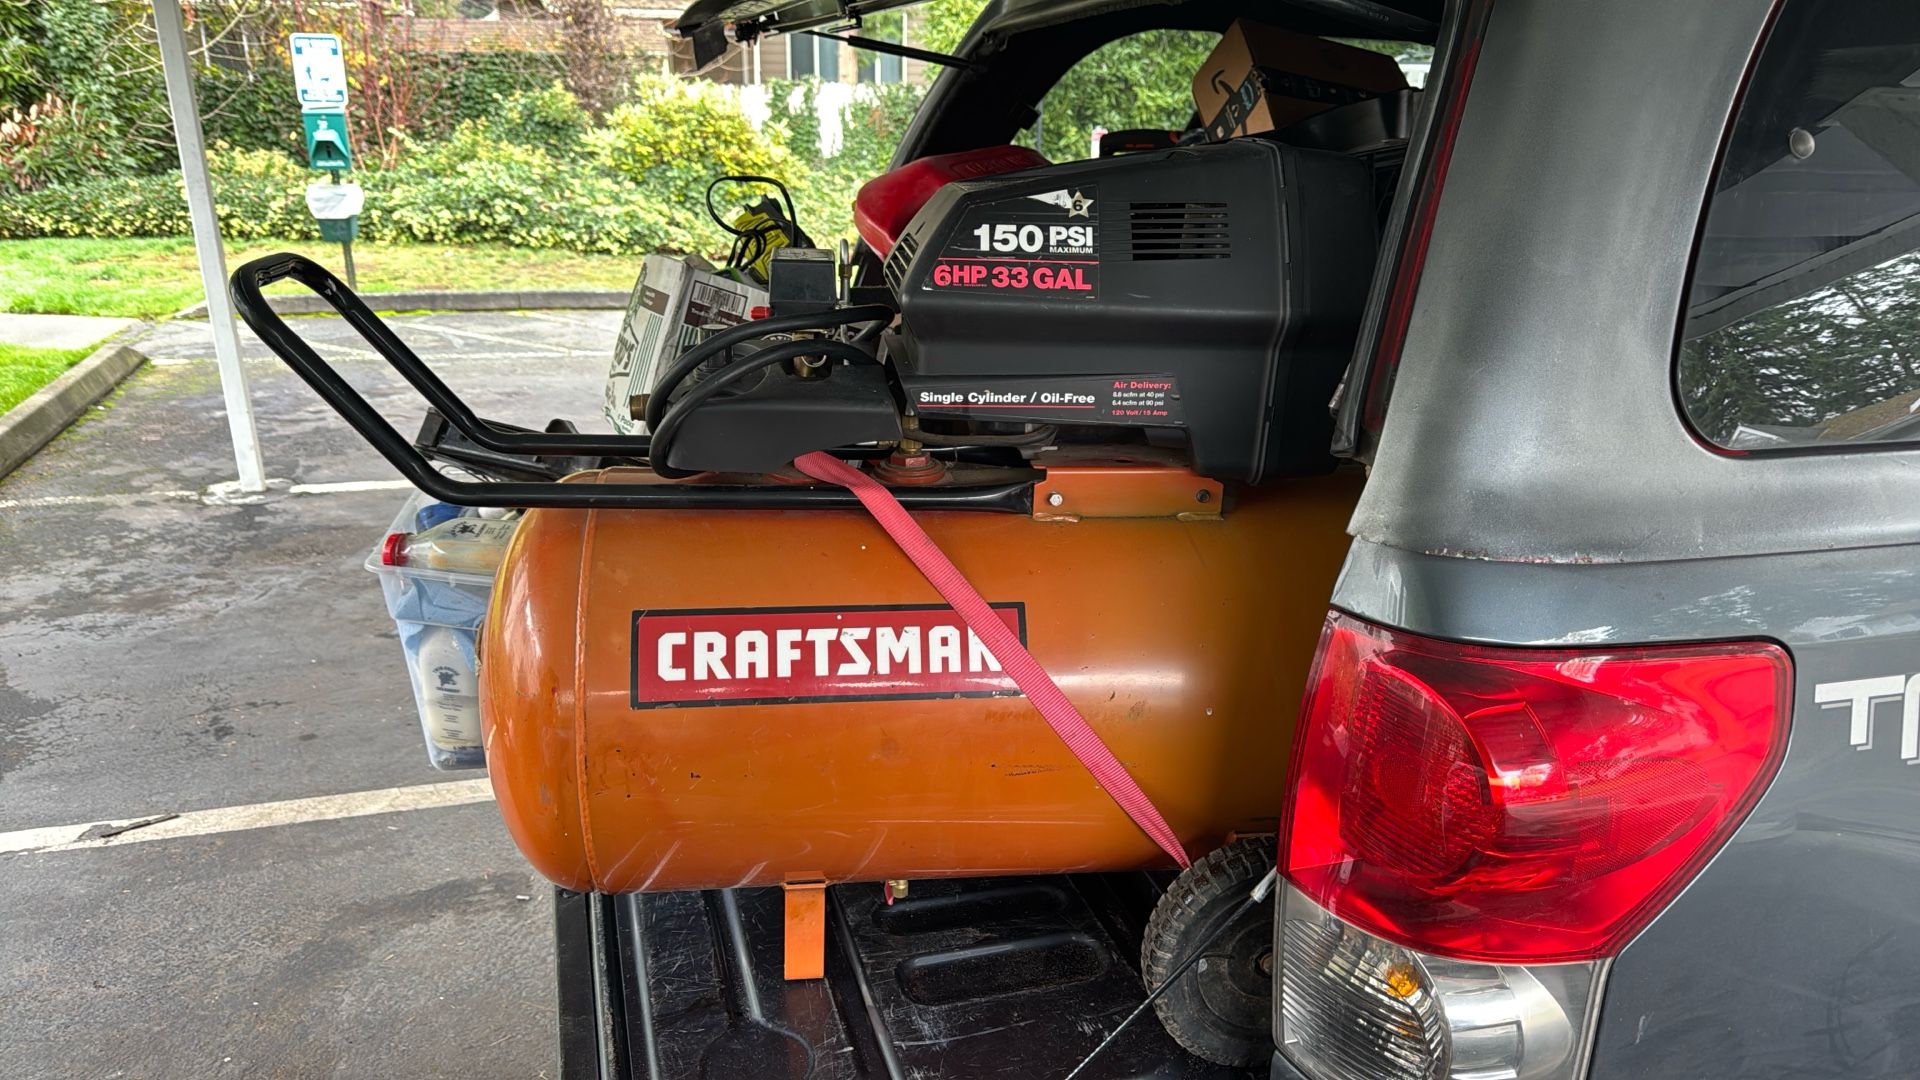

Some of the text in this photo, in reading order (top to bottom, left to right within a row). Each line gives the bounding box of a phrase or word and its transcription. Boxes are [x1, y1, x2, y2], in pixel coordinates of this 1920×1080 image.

[1073, 200, 1083, 211] 6
[973, 223, 1093, 253] 150 PSI
[1049, 246, 1093, 254] MAXIMUM
[934, 265, 1092, 290] 6HP 33 GAL
[1130, 381, 1172, 390] Delivery:
[919, 391, 964, 405] Single
[967, 391, 1027, 405] Cylinder
[1040, 392, 1096, 404] Oil-Free
[1152, 409, 1168, 417] Amp
